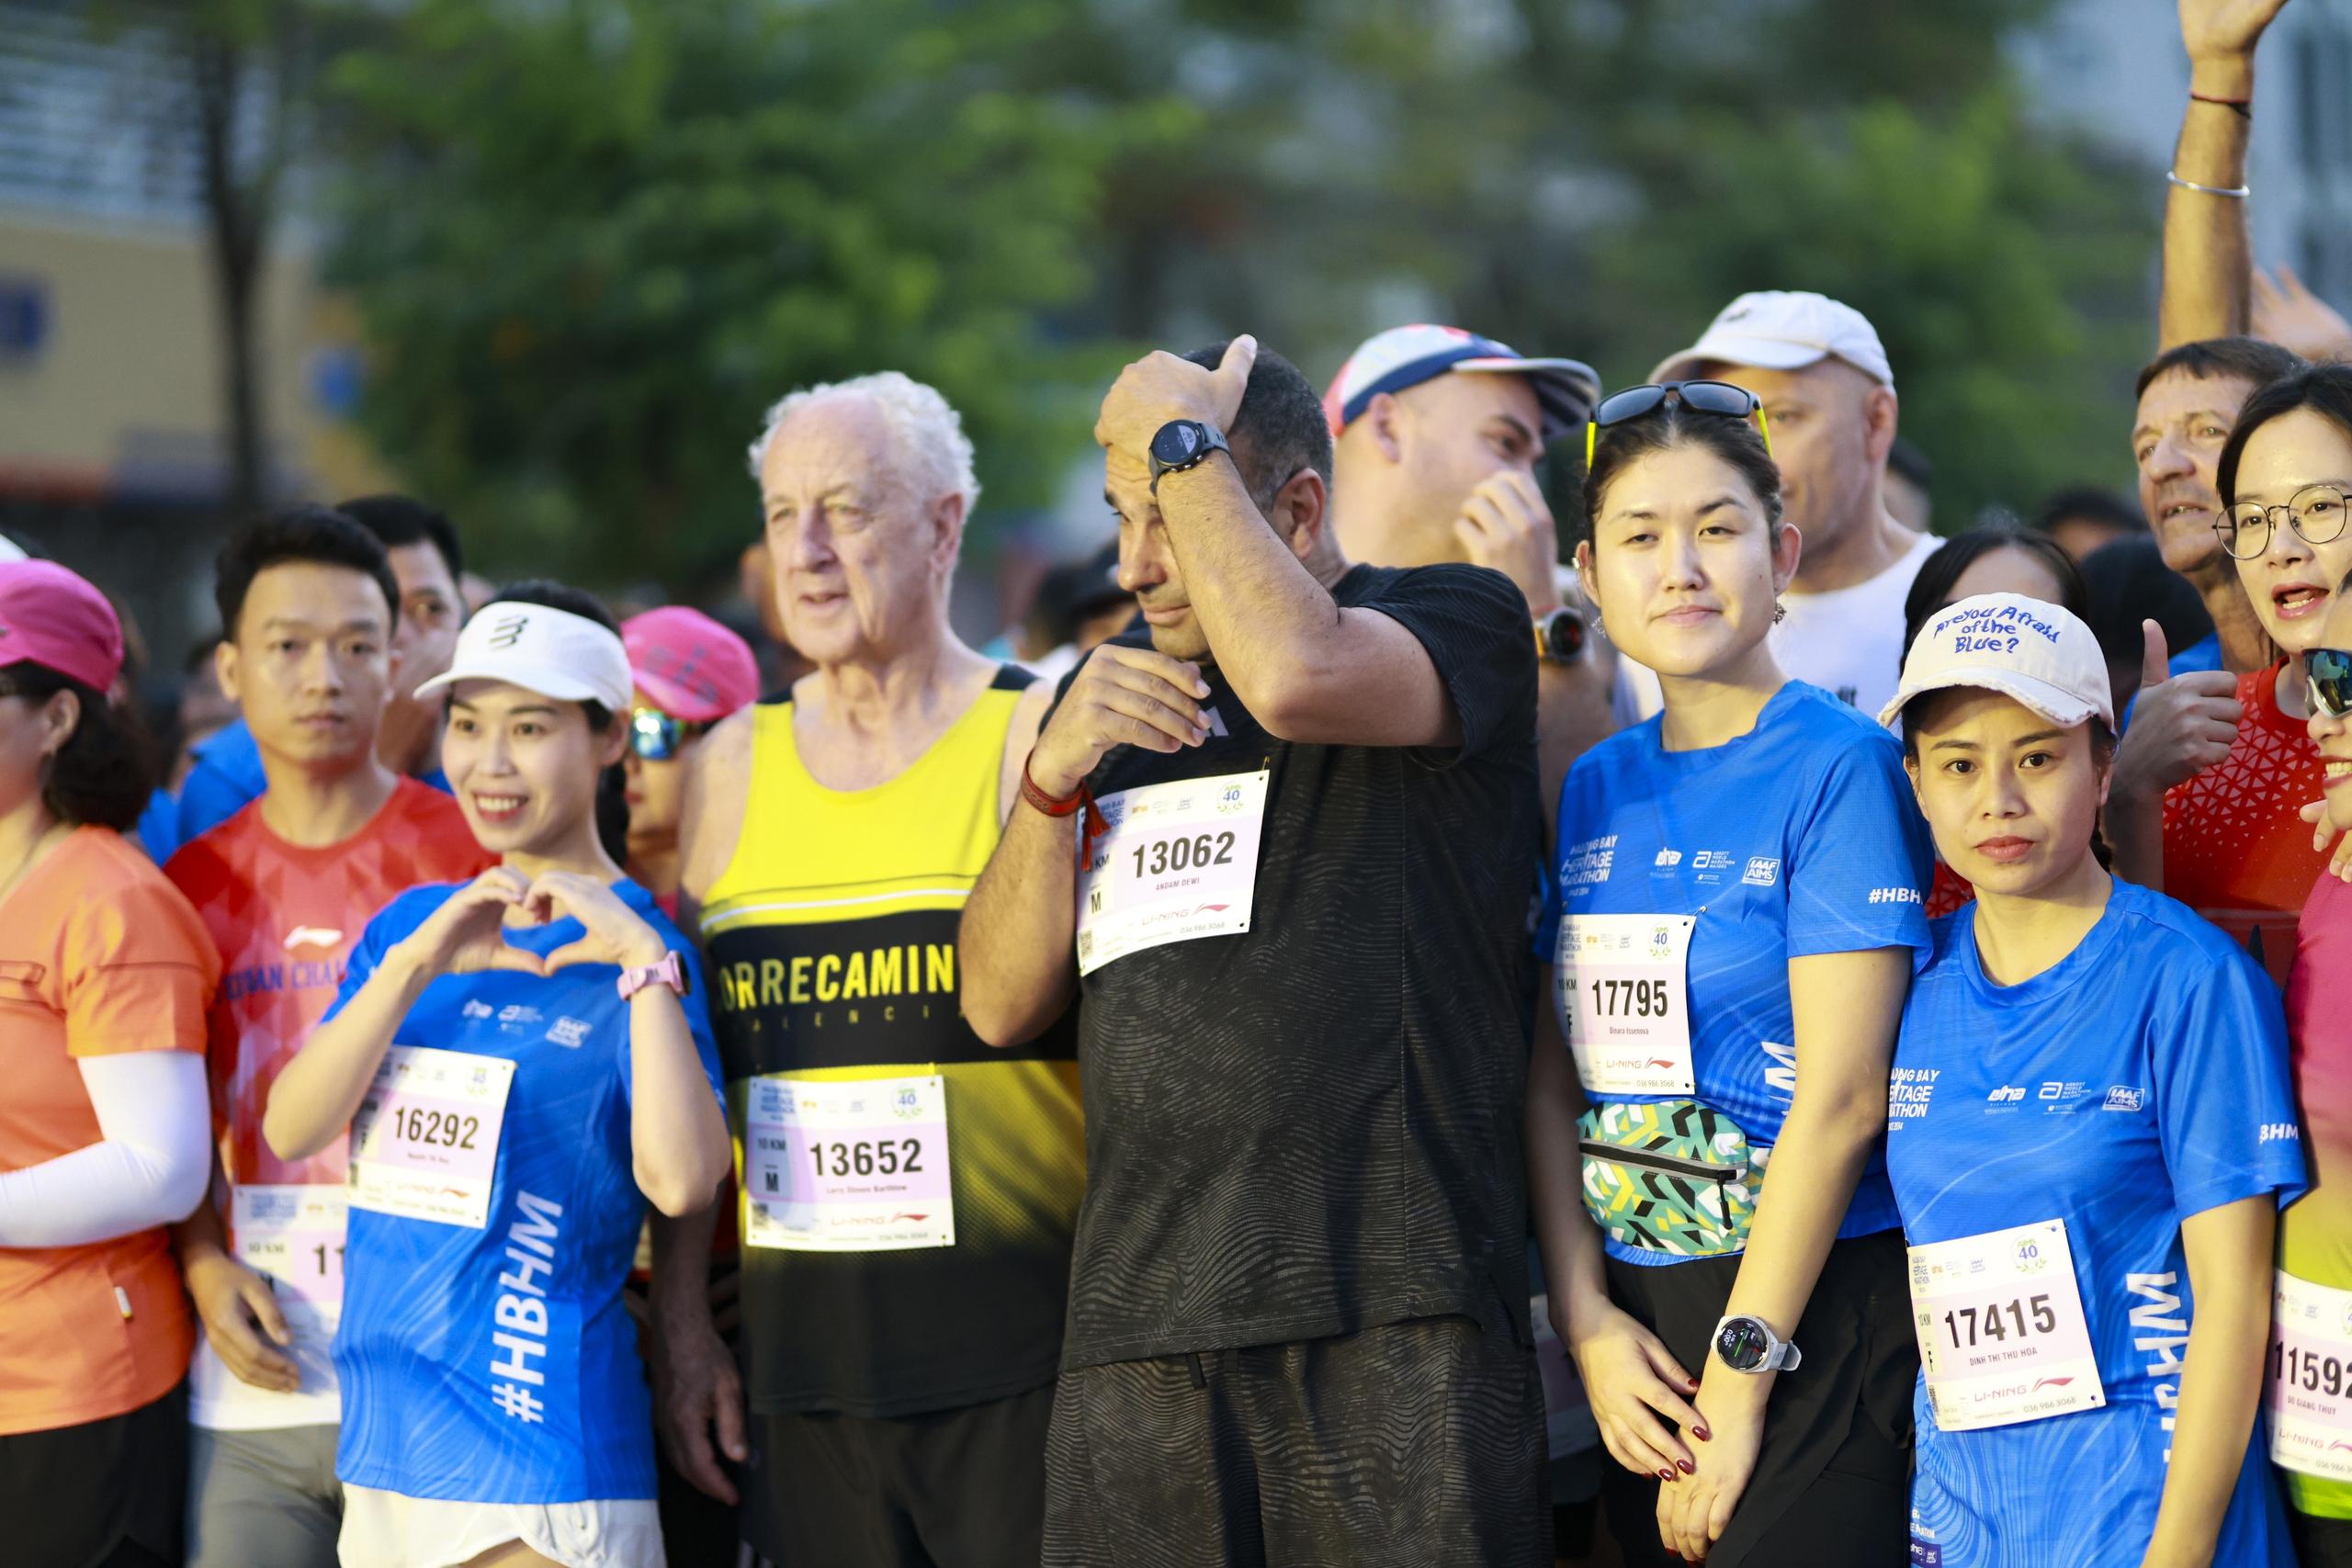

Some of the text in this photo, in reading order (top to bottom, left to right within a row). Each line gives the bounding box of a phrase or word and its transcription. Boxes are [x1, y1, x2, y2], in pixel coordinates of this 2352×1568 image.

[1996, 605, 2061, 644] Afraid
[1112, 799, 1125, 808] BAY
[1223, 789, 1240, 802] 40
[1103, 807, 1125, 819] TAGE
[1600, 835, 1618, 850] BAY
[1095, 854, 1110, 869] KM
[1133, 831, 1236, 878] 13062
[1749, 860, 1777, 869] IAAF
[1559, 868, 1610, 886] MARATHON
[1747, 868, 1773, 879] AIMS
[1156, 877, 1200, 891] ANDAM DEWI
[1091, 891, 1102, 914] M
[1869, 887, 1923, 905] #HBH
[1142, 909, 1190, 926] LI-NING
[1181, 921, 1226, 934] 036 986 3068
[1654, 932, 1668, 945] 40
[719, 944, 954, 1010] ORRECAMIN
[1566, 978, 1577, 990] KM
[1592, 979, 1668, 1017] 17795
[1606, 1060, 1642, 1069] LI-NING
[1916, 1069, 1940, 1082] BAY
[899, 1094, 916, 1105] 40
[2108, 1097, 2138, 1108] AIMS
[2111, 1089, 2142, 1100] IAAF
[395, 1106, 479, 1150] 16292
[2259, 1123, 2299, 1145] BHM
[810, 1138, 922, 1177] 13652
[765, 1171, 779, 1192] M
[2018, 1238, 2036, 1247] AIMS
[2018, 1245, 2039, 1259] 40
[491, 1190, 563, 1423] #HBHM
[1945, 1293, 2056, 1348] 17415
[1970, 1347, 2038, 1366] DINH THI THU HOA
[1974, 1384, 2027, 1402] LI-NING
[2023, 1396, 2076, 1413] 036 986 3068
[2288, 1395, 2336, 1415] DO GIANG THUY
[2278, 1428, 2324, 1449] LI-NING
